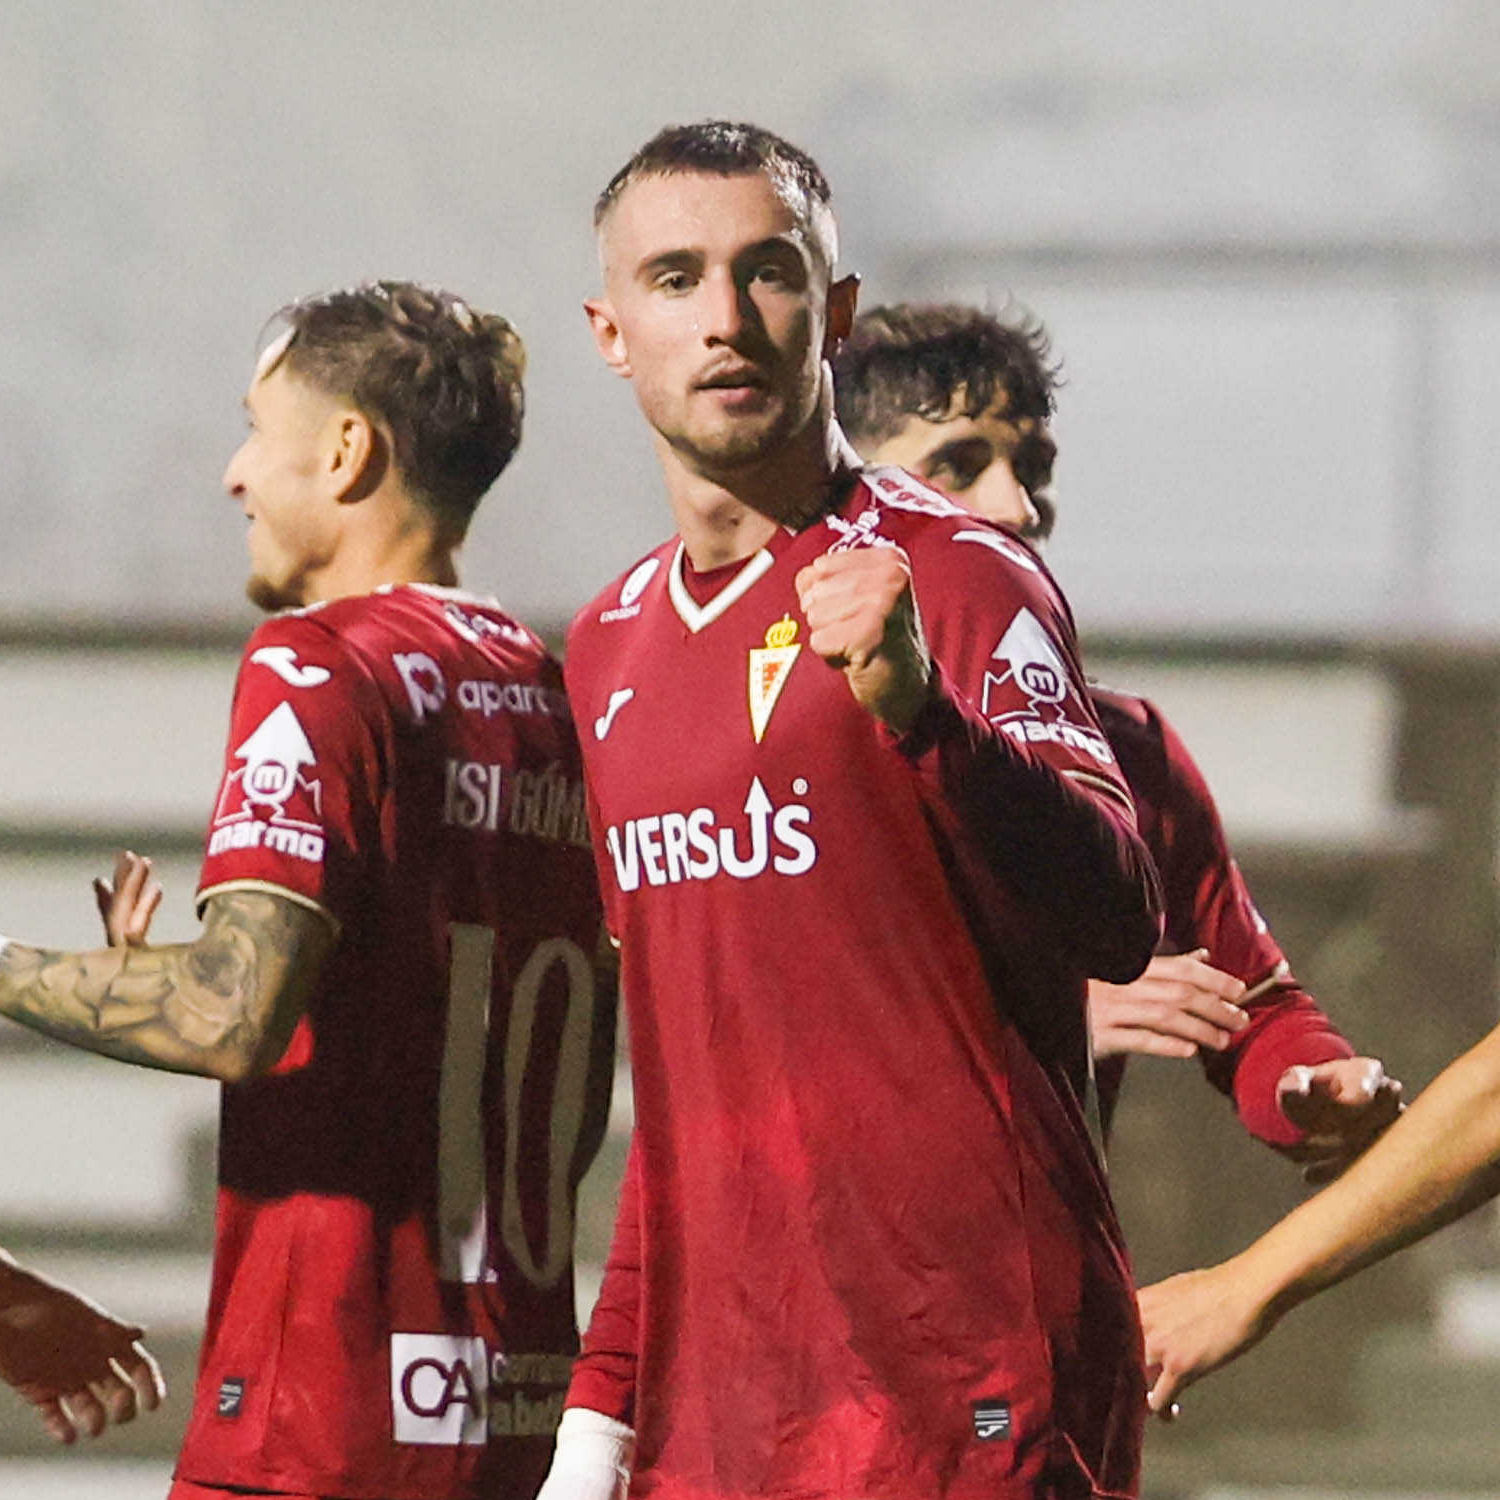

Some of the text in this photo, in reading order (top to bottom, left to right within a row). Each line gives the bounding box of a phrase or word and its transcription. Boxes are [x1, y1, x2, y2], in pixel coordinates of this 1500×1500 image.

[606, 775, 818, 892] VERSUS
[437, 920, 596, 1288] 10
[402, 1358, 481, 1420] CA
